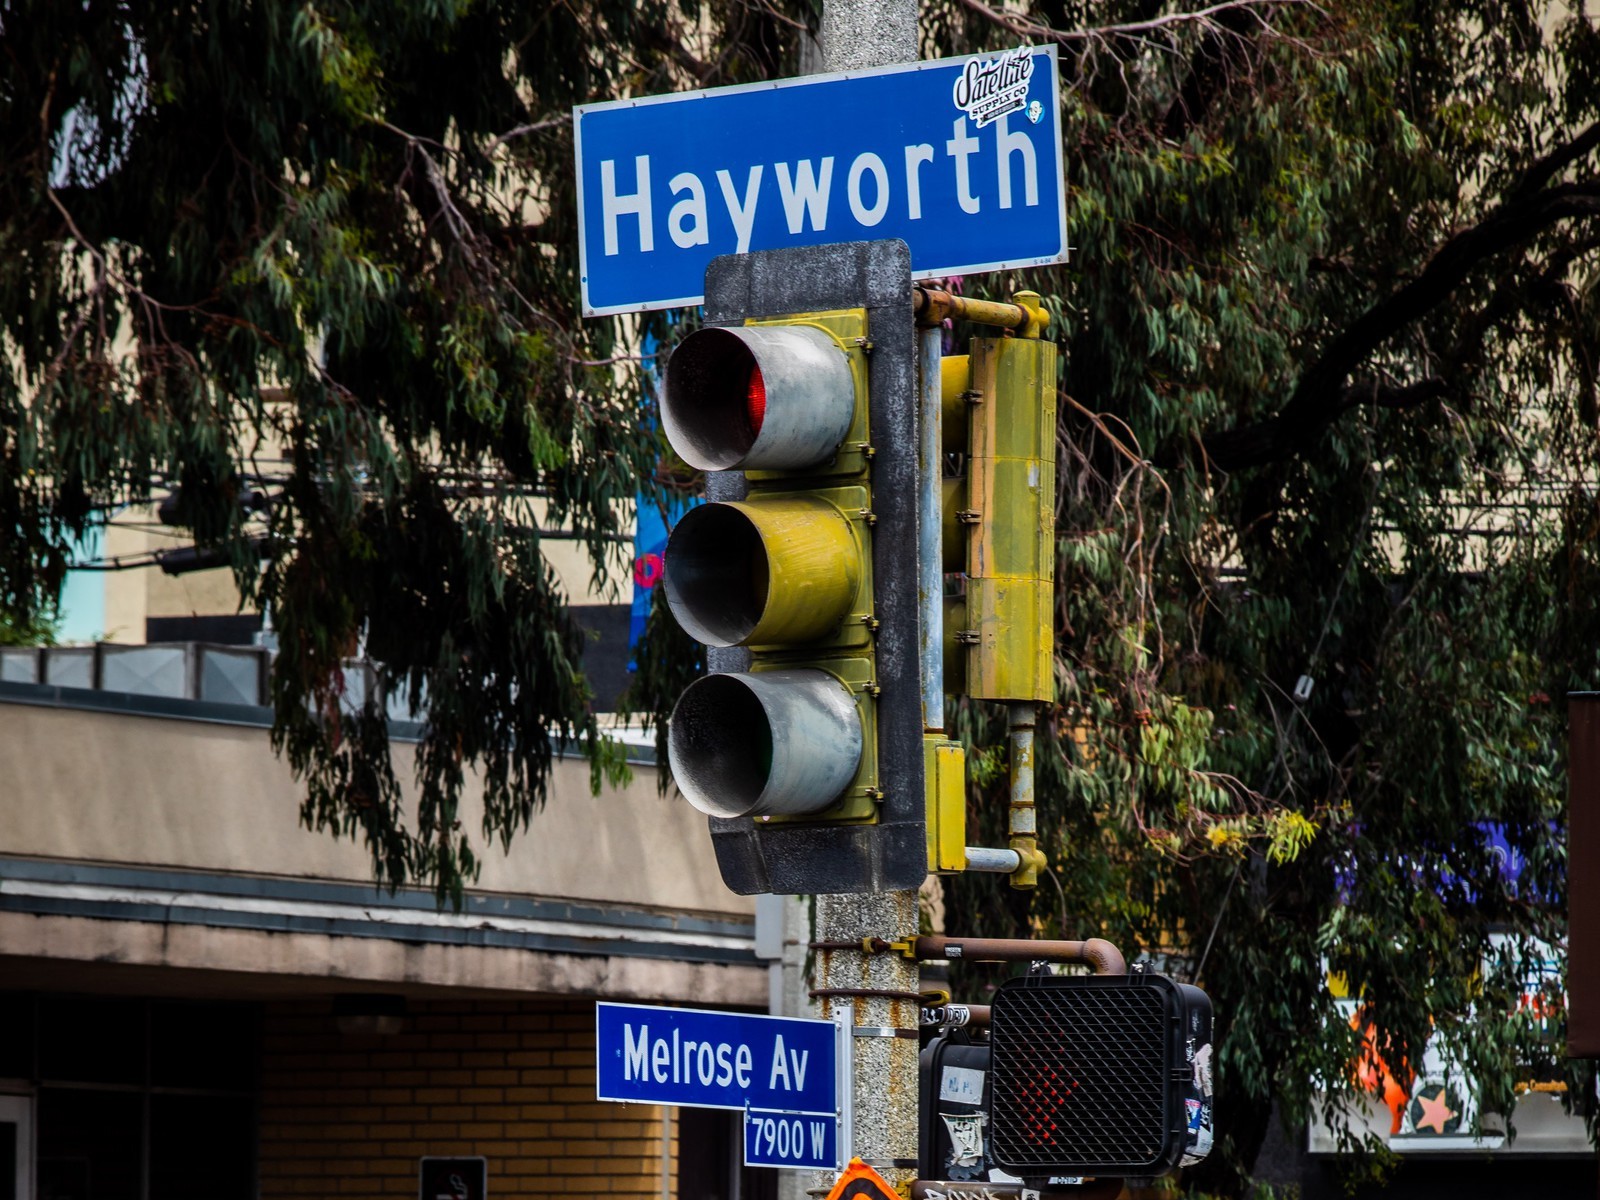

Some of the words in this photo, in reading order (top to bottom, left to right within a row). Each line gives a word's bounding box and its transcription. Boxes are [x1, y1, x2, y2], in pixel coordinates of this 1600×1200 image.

[972, 92, 1012, 117] SUPPLY
[1013, 86, 1026, 98] CO
[600, 116, 1039, 256] Hayworth
[624, 1023, 753, 1089] Melrose
[769, 1034, 809, 1092] Av
[752, 1118, 804, 1159] 7900
[811, 1121, 825, 1160] W
